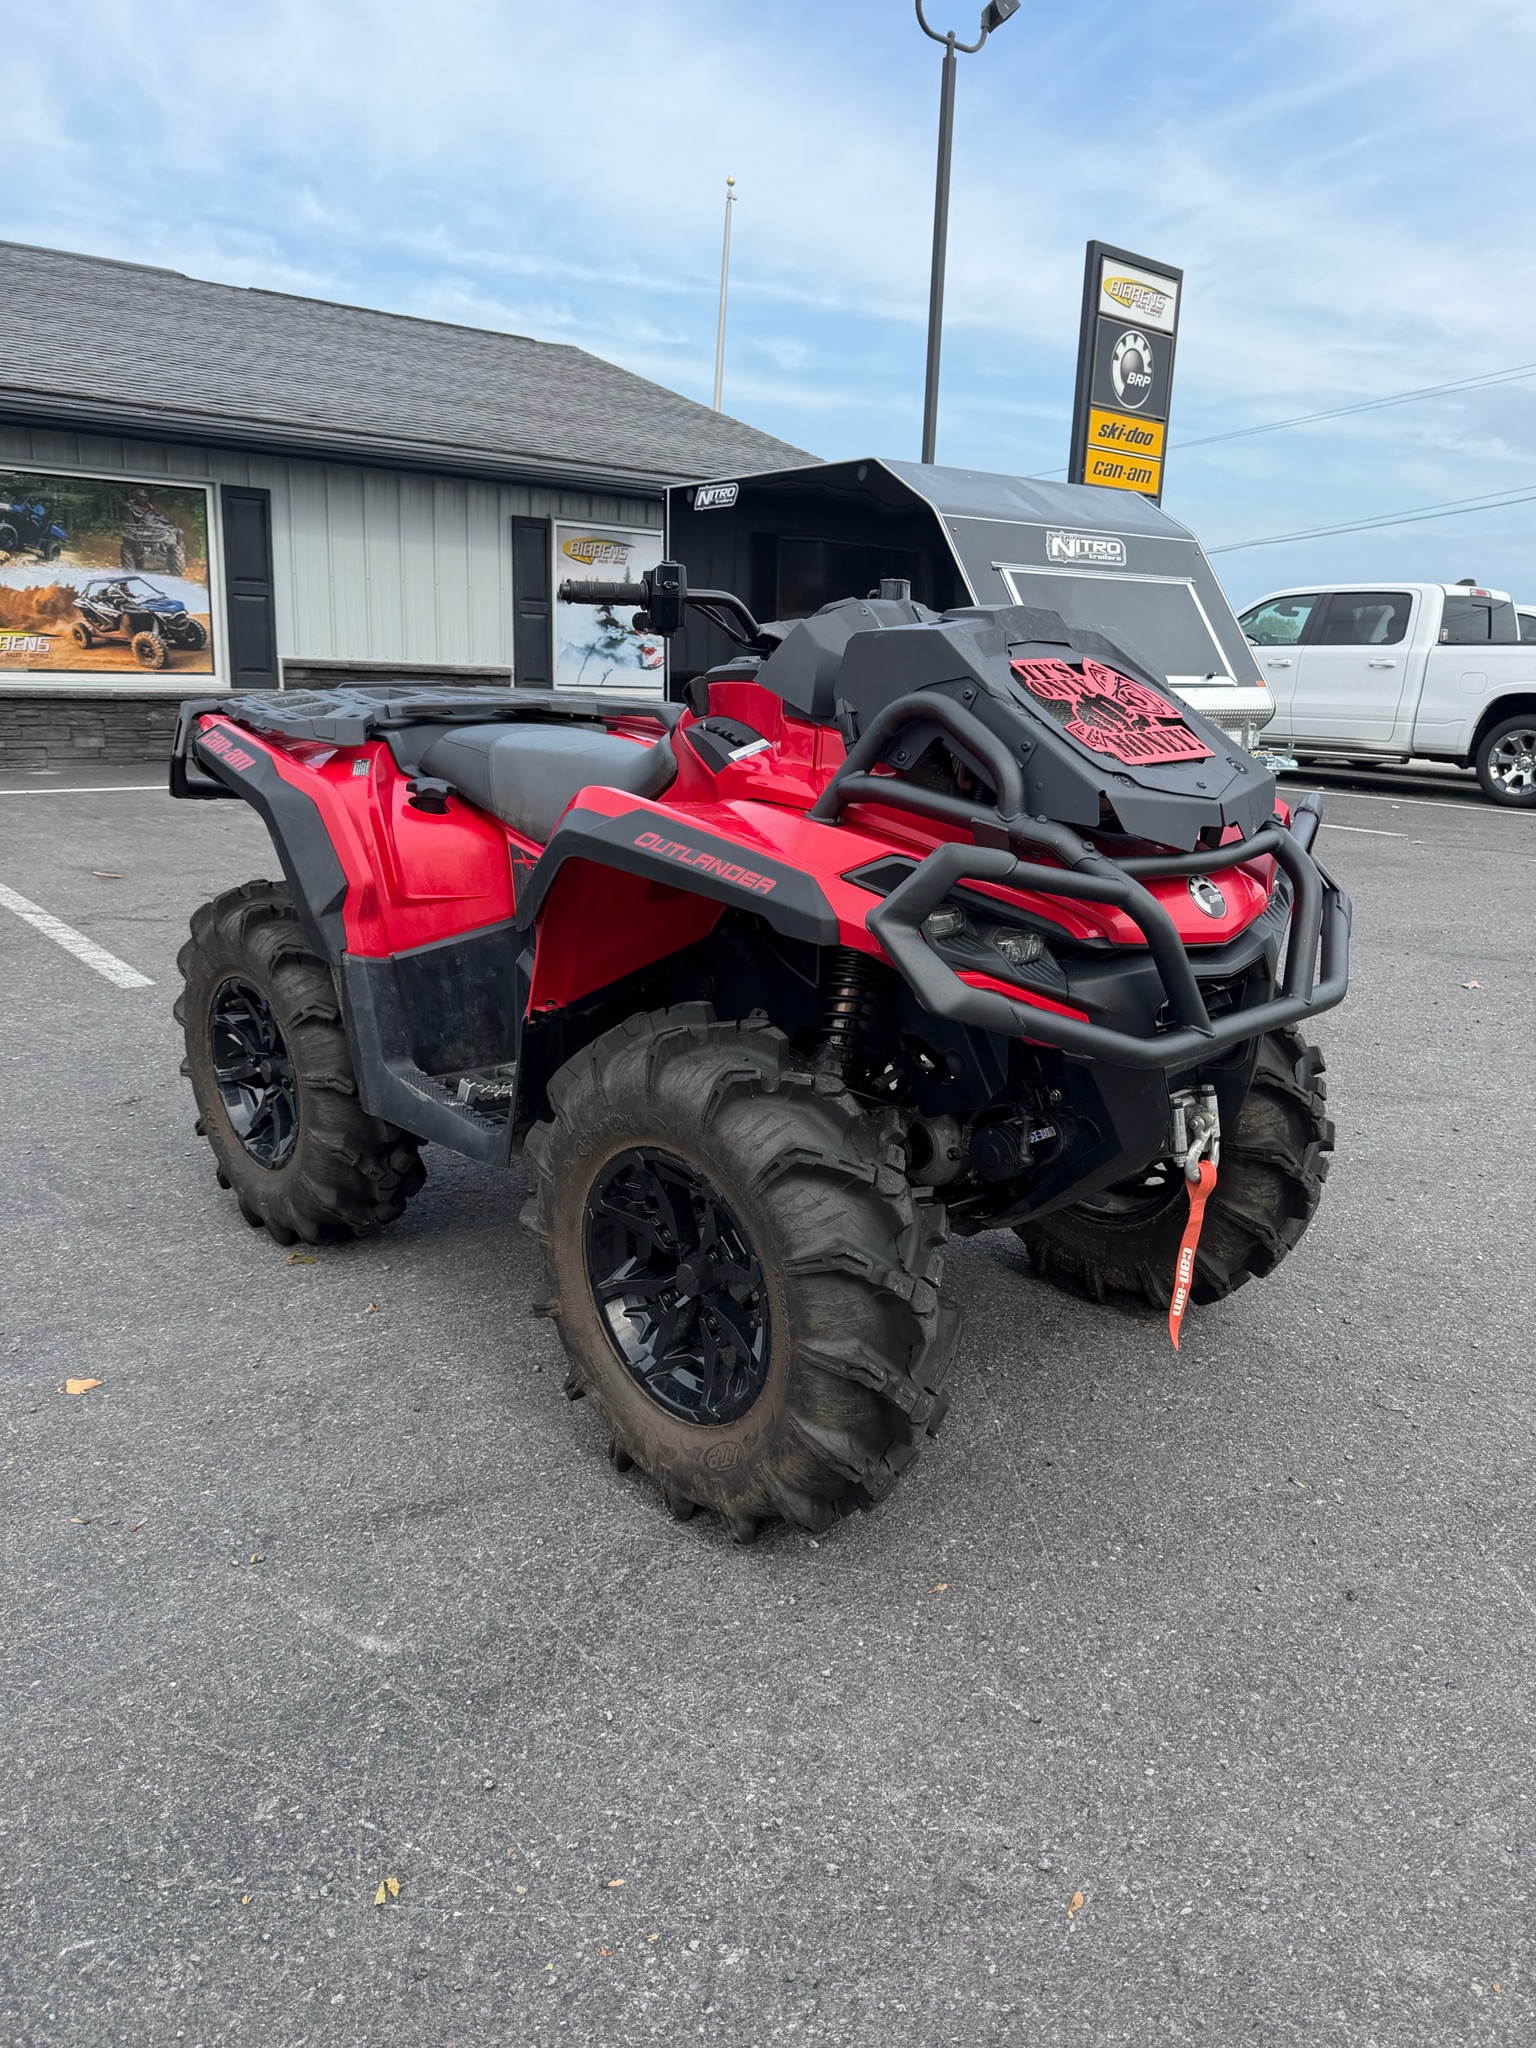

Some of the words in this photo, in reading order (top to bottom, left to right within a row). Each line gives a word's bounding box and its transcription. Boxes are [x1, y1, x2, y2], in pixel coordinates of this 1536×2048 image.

[1110, 280, 1166, 310] BIBBENS
[1126, 371, 1151, 388] BRP
[1097, 422, 1154, 446] ski-doo
[1092, 460, 1153, 484] can-am
[697, 487, 736, 506] NITRO
[570, 542, 629, 561] BIBBENS
[1051, 537, 1121, 558] NITRO
[1088, 553, 1122, 561] trailers
[1017, 663, 1074, 681] IT'S
[200, 730, 257, 772] can-am
[1104, 728, 1206, 757] MONEY!
[634, 832, 777, 895] OUTLANDER
[1208, 893, 1223, 904] BRP
[1172, 1247, 1193, 1317] can-am
[708, 1444, 740, 1470] ITP
